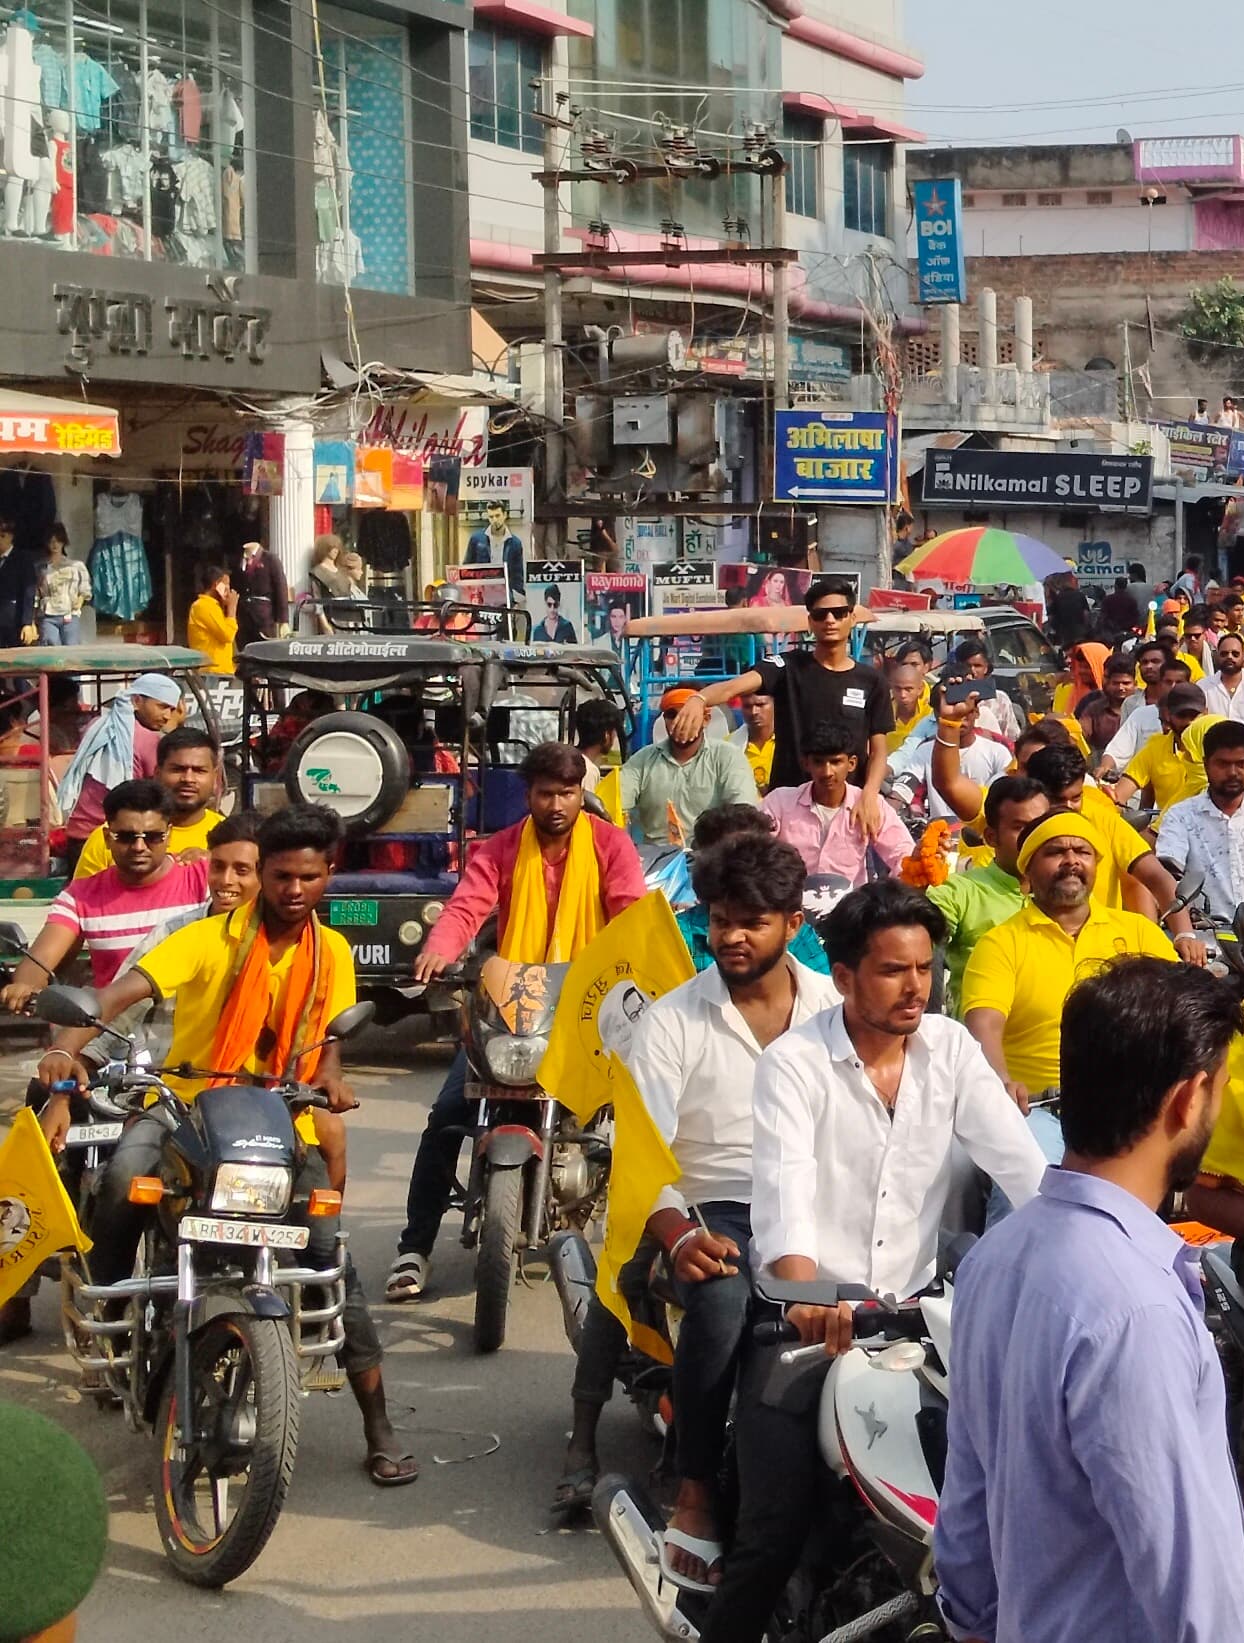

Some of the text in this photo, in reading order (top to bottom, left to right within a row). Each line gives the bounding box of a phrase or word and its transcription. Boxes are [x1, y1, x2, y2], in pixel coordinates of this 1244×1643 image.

[920, 219, 953, 237] BOI
[786, 422, 885, 450] अभिलाषा
[793, 457, 875, 480] बाजार
[466, 473, 508, 489] spykar
[955, 473, 1141, 498] Nilkamal SLEEP
[528, 573, 580, 583] MUFTI
[591, 573, 644, 590] Raymond
[656, 575, 711, 585] MUFTI
